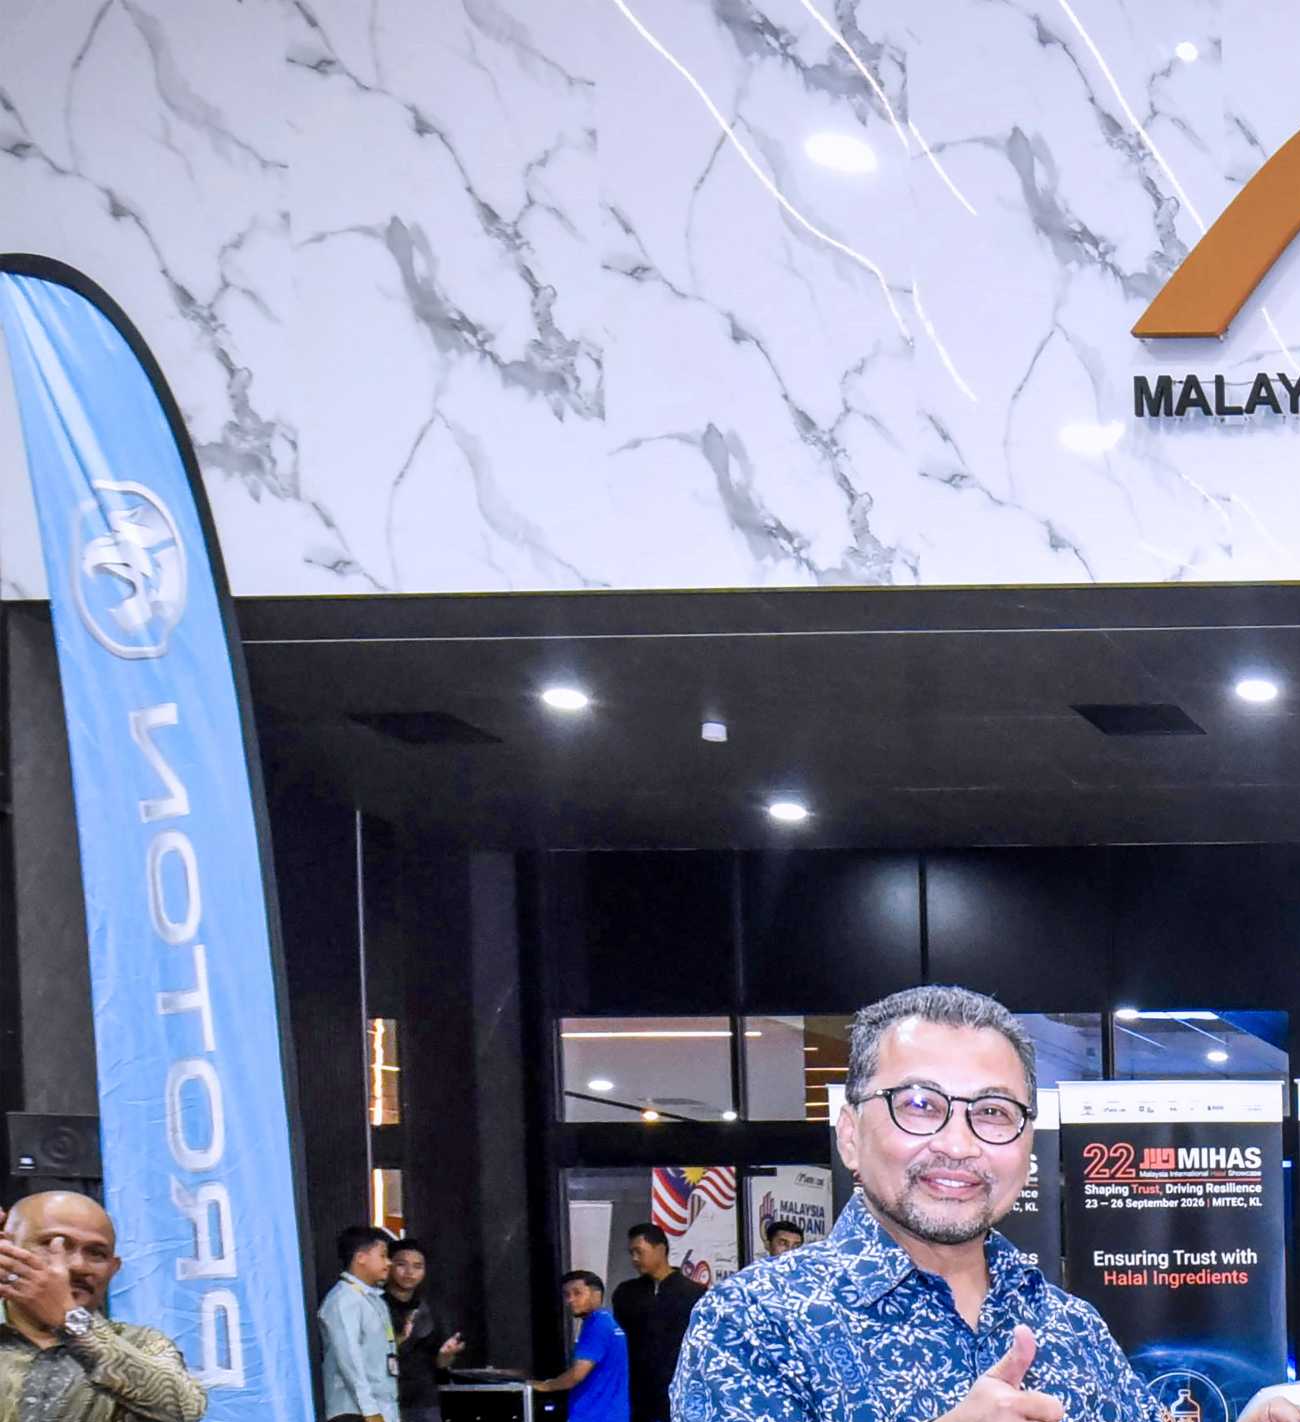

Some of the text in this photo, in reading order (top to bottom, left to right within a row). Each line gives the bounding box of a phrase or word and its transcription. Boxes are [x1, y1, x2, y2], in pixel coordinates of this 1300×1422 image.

[1083, 1143, 1262, 1178] 22 MIHAS
[1085, 1183, 1262, 1196] Shaping Trust, Driving Resilience
[780, 1200, 825, 1218] MALAYSIA
[1085, 1199, 1098, 1208] 23
[1111, 1199, 1123, 1208] 26
[1126, 1198, 1178, 1209] September
[1181, 1198, 1204, 1207] 2026
[1213, 1198, 1247, 1208] MITEC,
[1249, 1198, 1262, 1206] KL
[1093, 1249, 1257, 1269] Ensuring Trust with
[1104, 1271, 1248, 1288] Halal Ingredients
